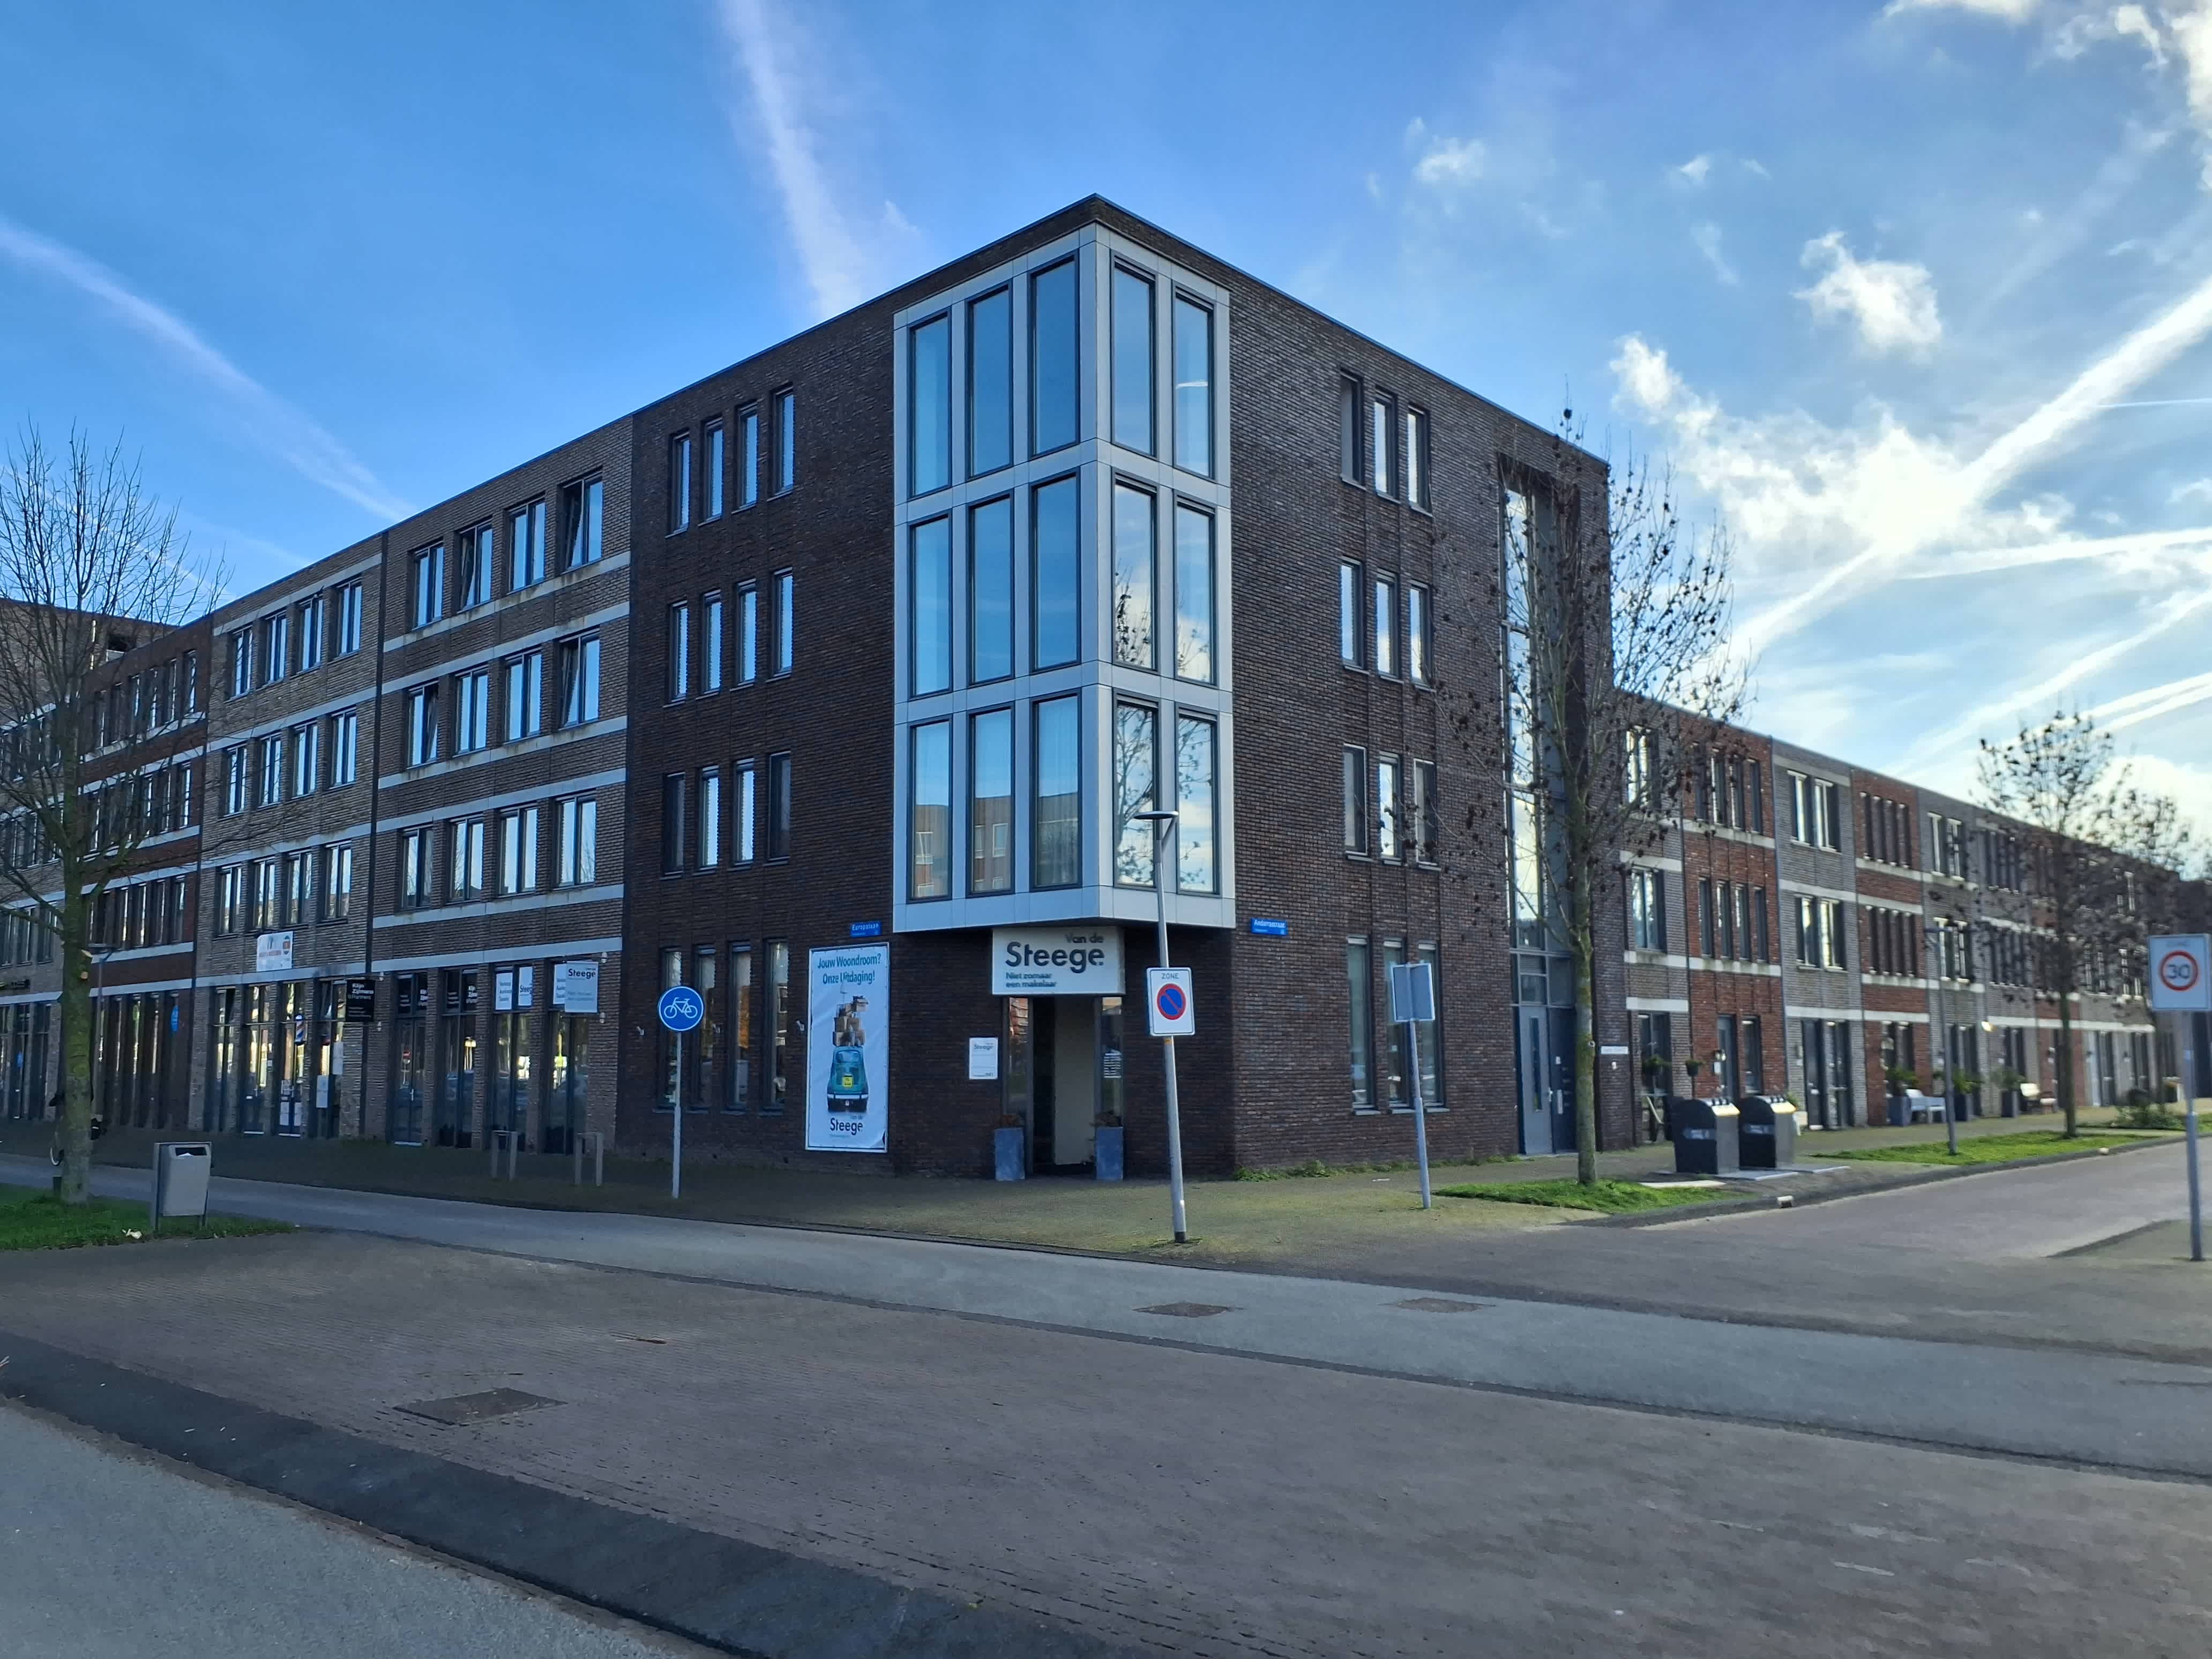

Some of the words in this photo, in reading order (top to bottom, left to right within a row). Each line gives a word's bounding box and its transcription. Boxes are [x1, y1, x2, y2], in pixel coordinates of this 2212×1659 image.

[1065, 933, 1086, 944] Van
[1089, 932, 1104, 944] de
[818, 958, 835, 969] Jouw
[836, 953, 881, 968] Woondroom?
[568, 968, 596, 980] Steege
[823, 973, 839, 984] Onze
[840, 970, 875, 985] Uitdaging!
[2167, 964, 2190, 979] 30
[829, 1117, 863, 1135] Steege
